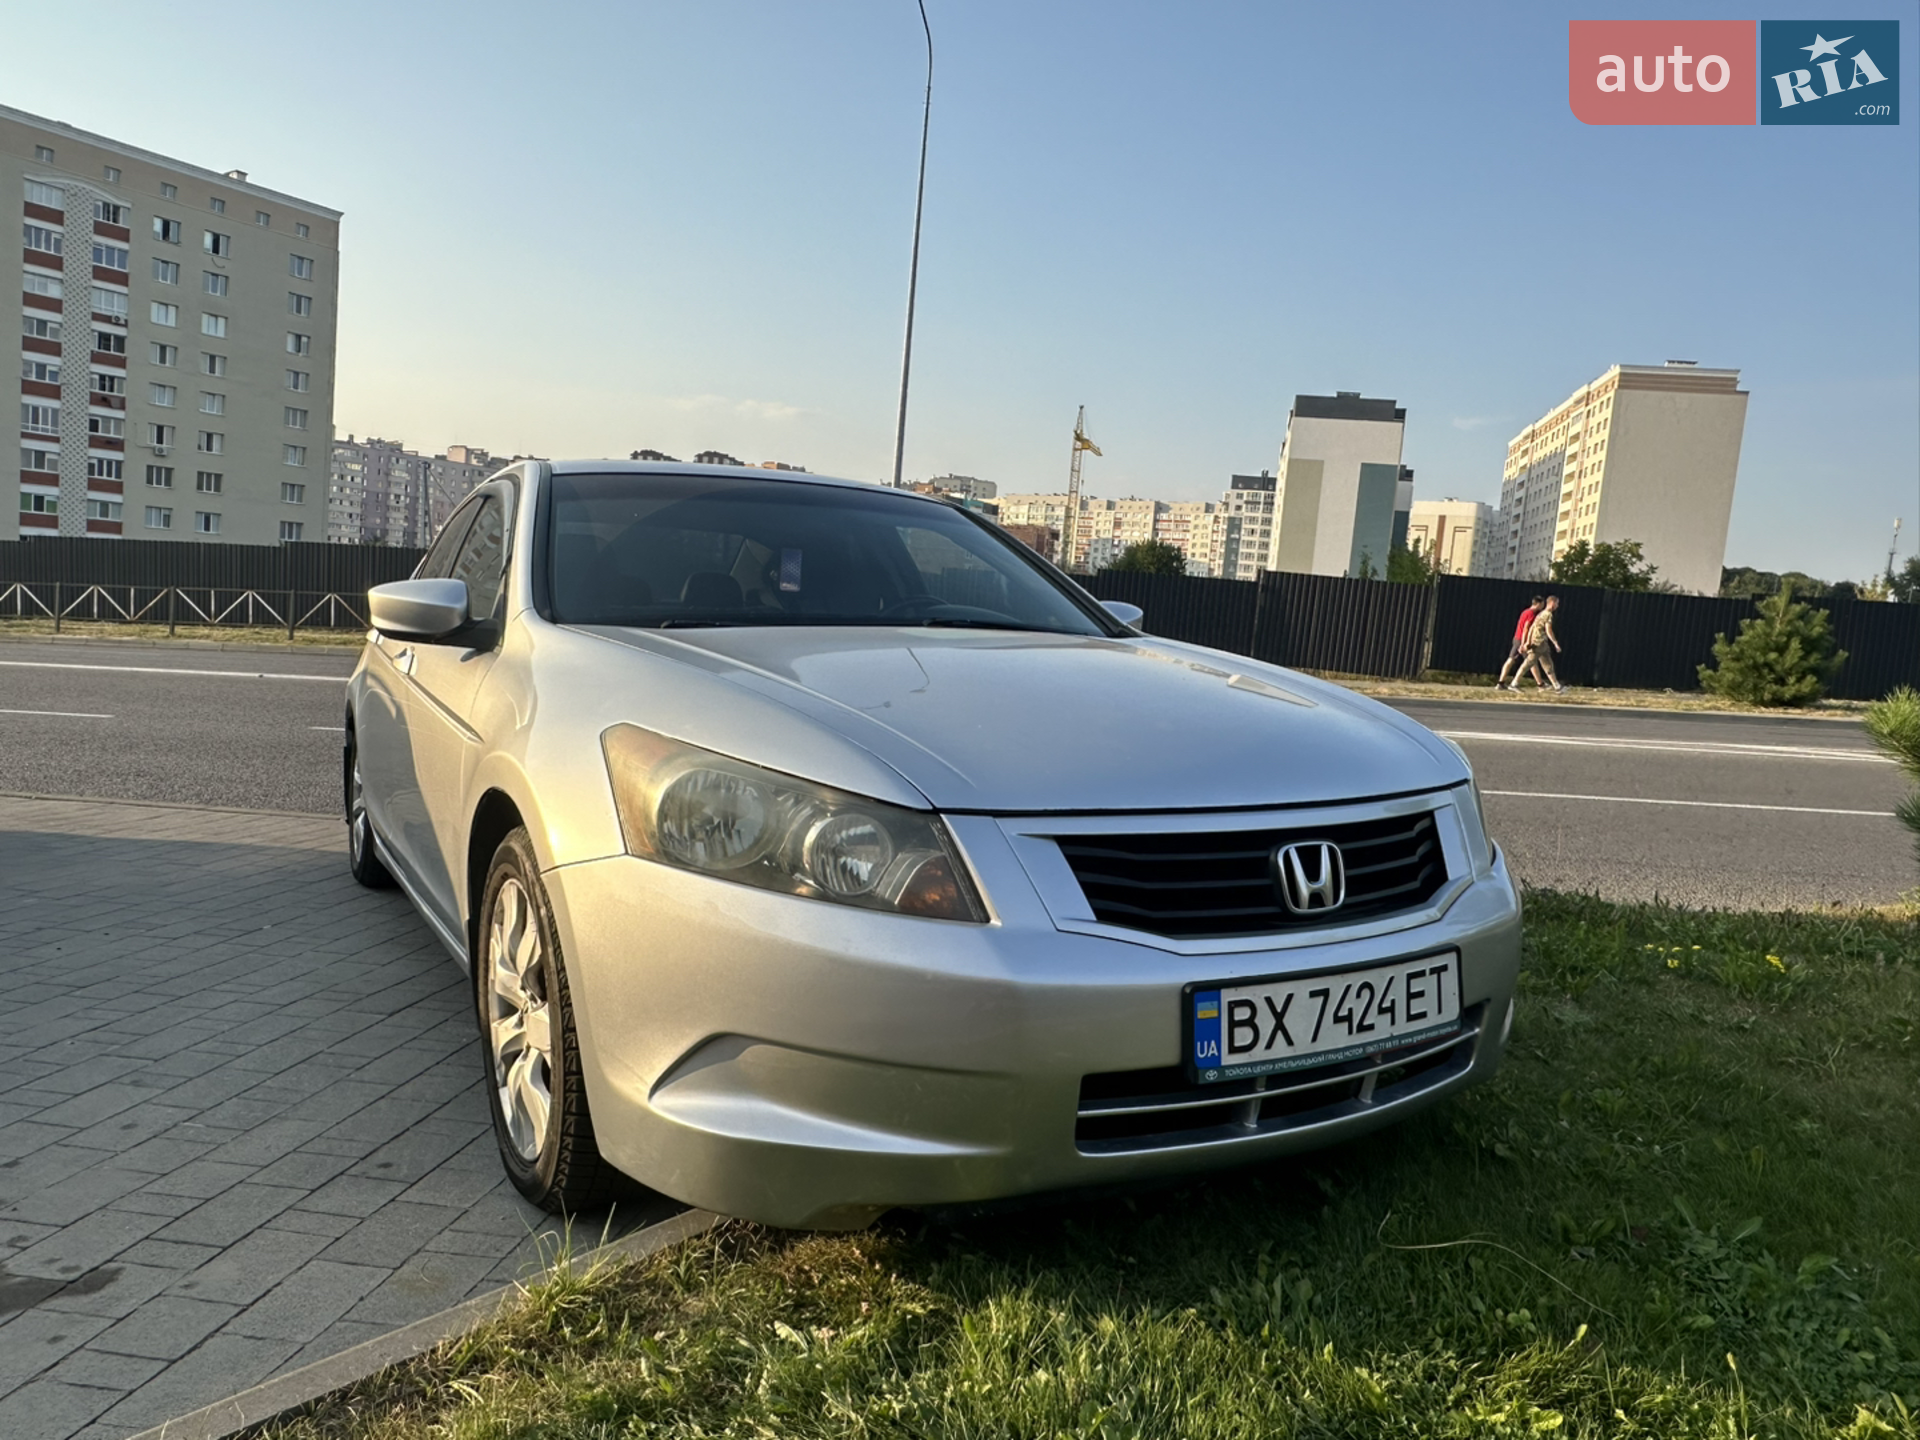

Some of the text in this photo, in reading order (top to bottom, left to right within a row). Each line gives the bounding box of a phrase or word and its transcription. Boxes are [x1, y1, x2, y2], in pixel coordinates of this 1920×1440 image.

[1227, 963, 1448, 1055] BX 7424 ET
[1197, 1040, 1218, 1058] UA
